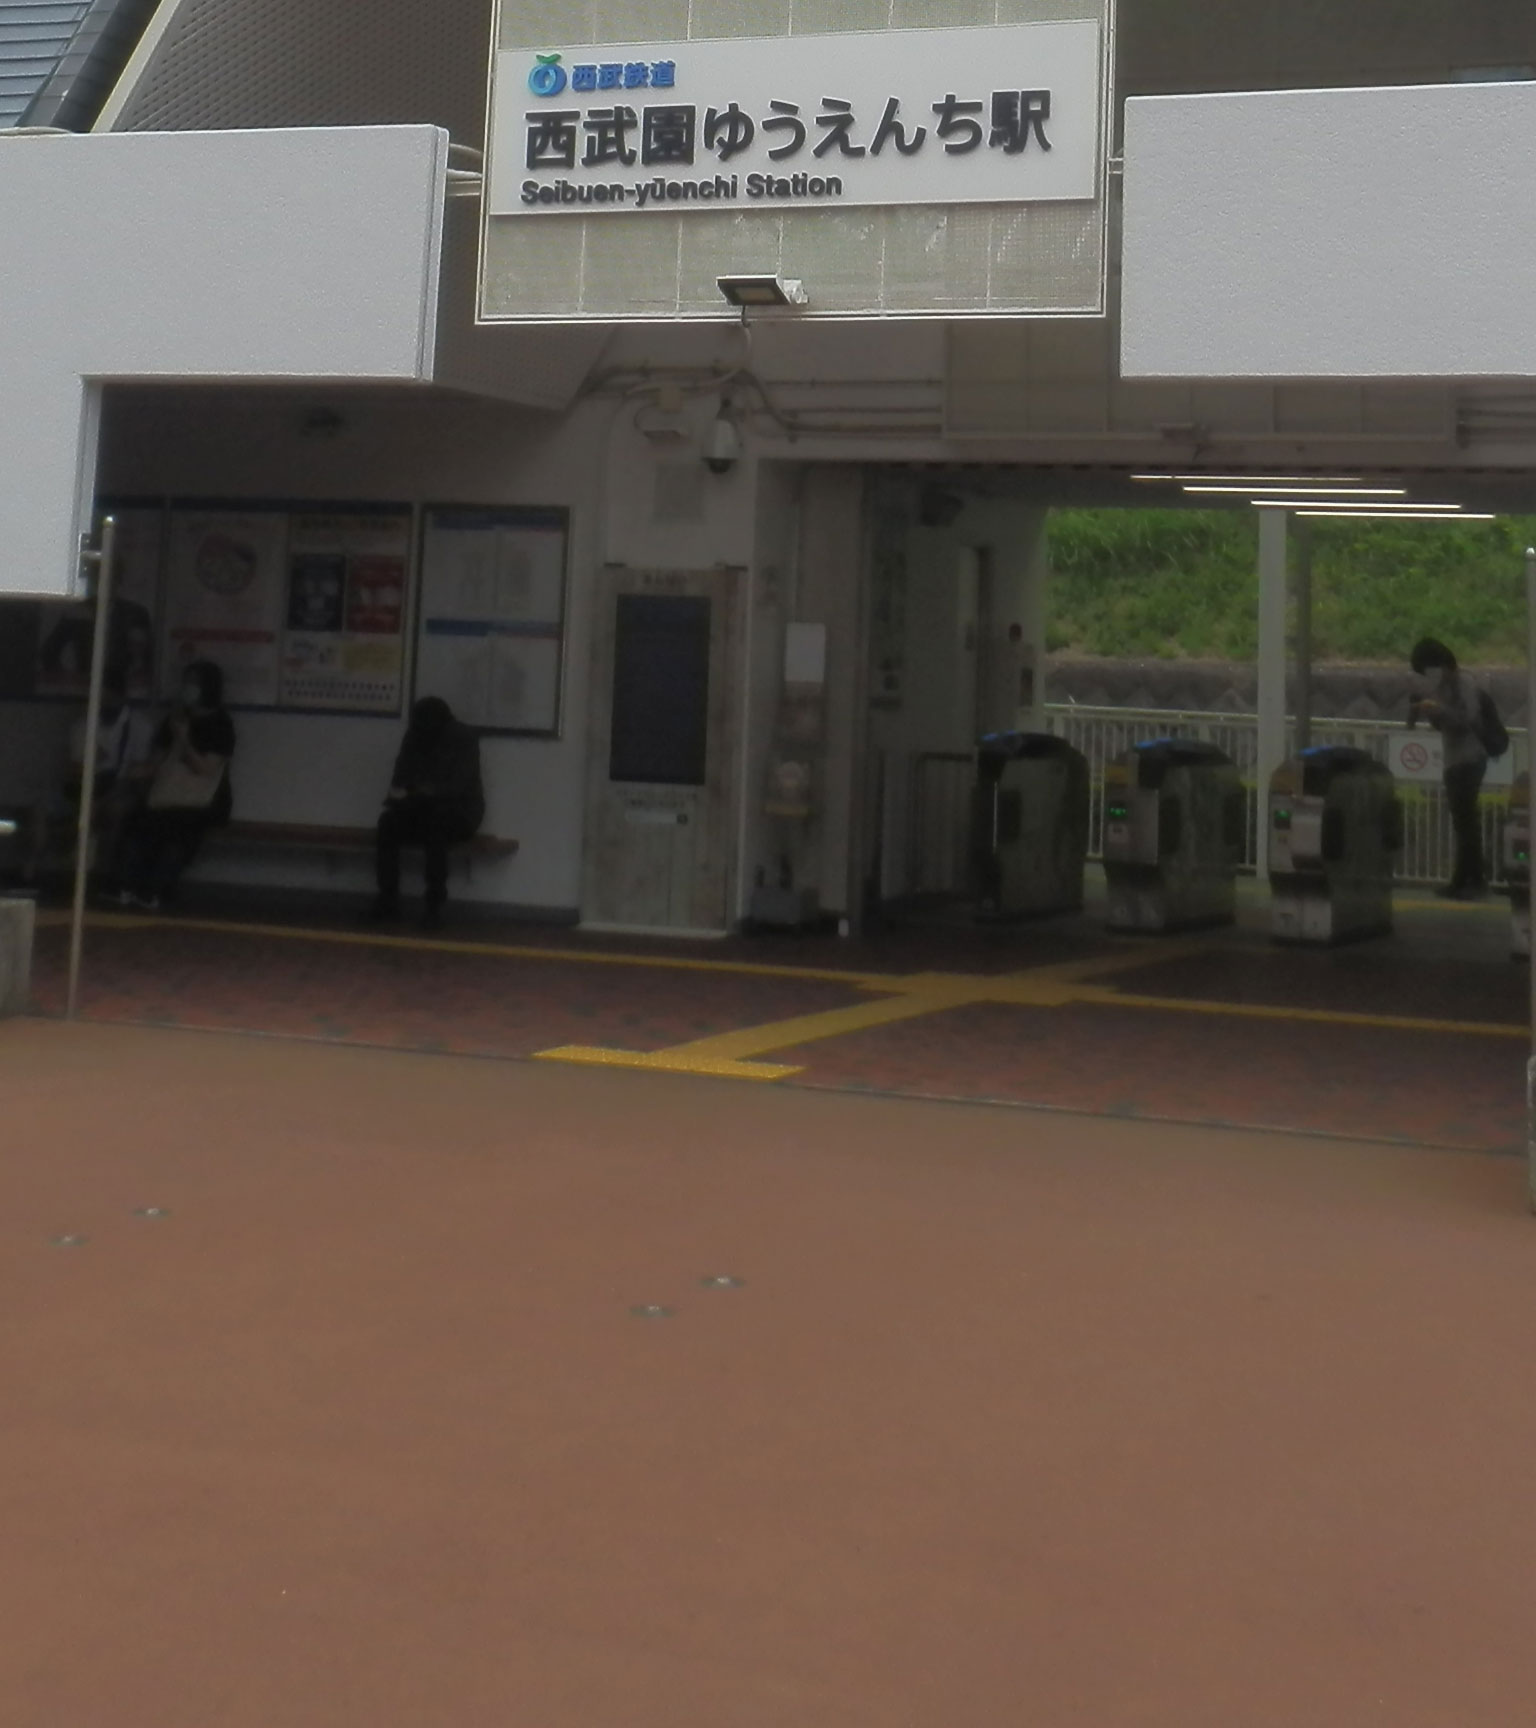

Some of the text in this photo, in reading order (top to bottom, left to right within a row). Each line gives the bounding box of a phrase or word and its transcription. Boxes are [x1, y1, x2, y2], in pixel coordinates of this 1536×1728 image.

[573, 61, 676, 92] 西武鉄道
[525, 90, 1051, 170] 西武園ゆうえんち駅
[521, 173, 842, 206] Seibuen-yūenchi Station
